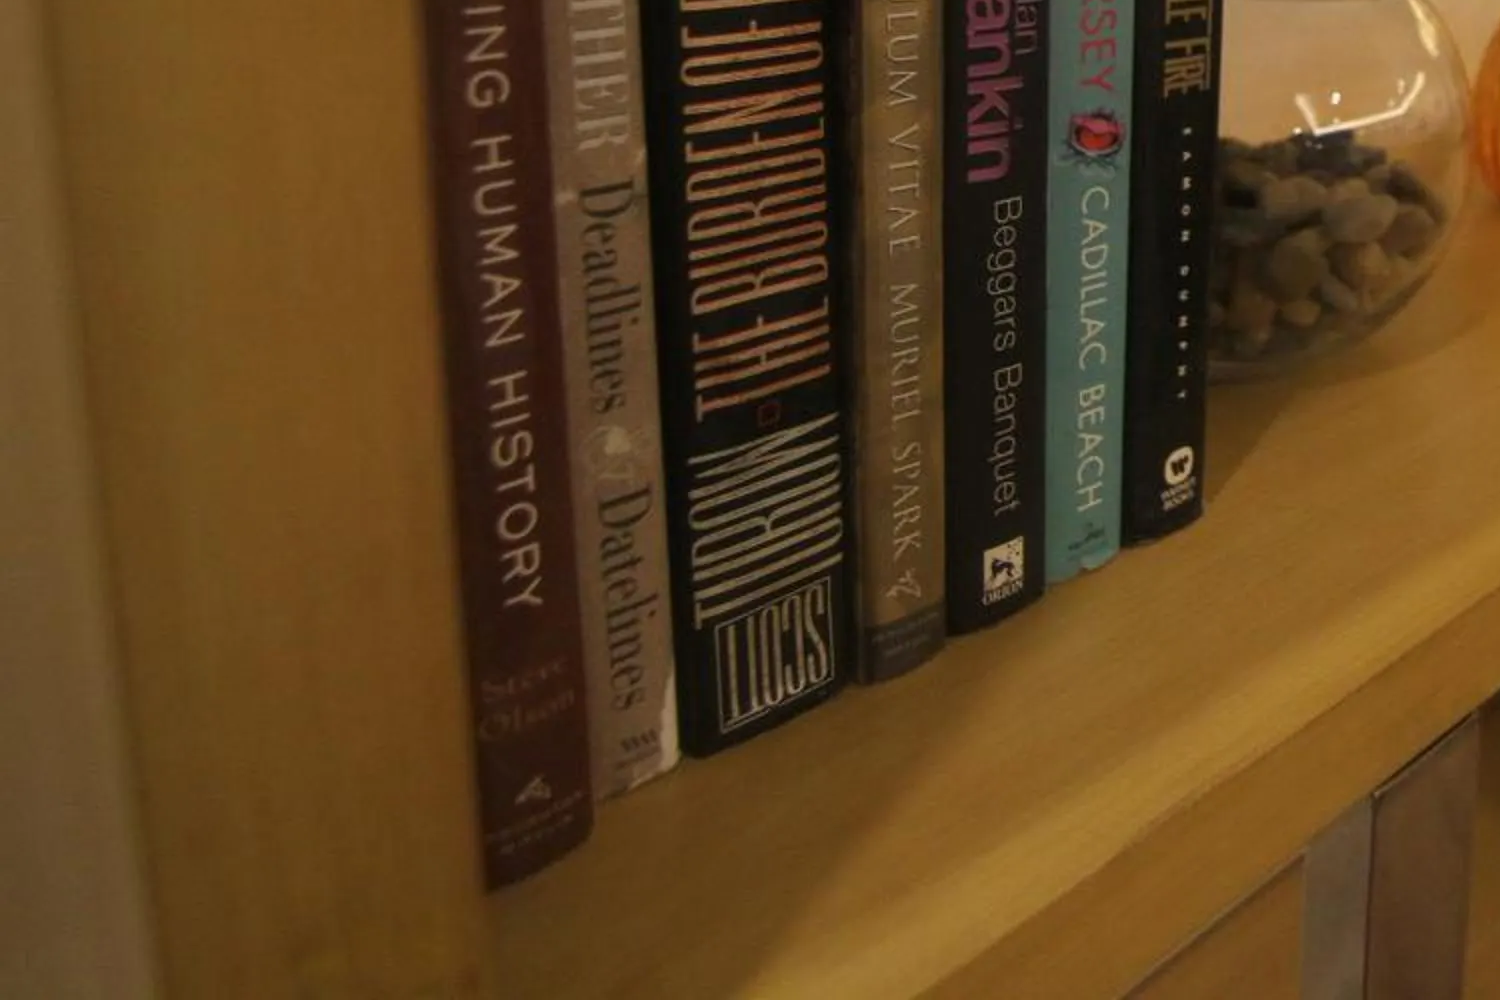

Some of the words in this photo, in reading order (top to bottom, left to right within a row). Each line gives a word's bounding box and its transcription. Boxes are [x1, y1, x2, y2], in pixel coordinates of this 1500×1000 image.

[680, 18, 825, 88] OF
[1162, 30, 1211, 99] FIRE
[469, 134, 524, 351] HUMAN
[683, 81, 829, 316] BURDEN
[887, 123, 922, 258] VITAE
[578, 177, 643, 414] Deadlines
[985, 195, 1023, 352] Beggars
[1077, 185, 1110, 372] CADILLAC
[691, 294, 832, 423] THE
[889, 281, 922, 433] MURIEL
[487, 369, 543, 609] HISTORY
[890, 441, 922, 561] SPARK
[986, 361, 1023, 517] Banquet
[1075, 383, 1106, 513] BEACH
[598, 482, 659, 711] Datelines
[686, 411, 844, 630] TUROW
[721, 582, 830, 727] SCOTT
